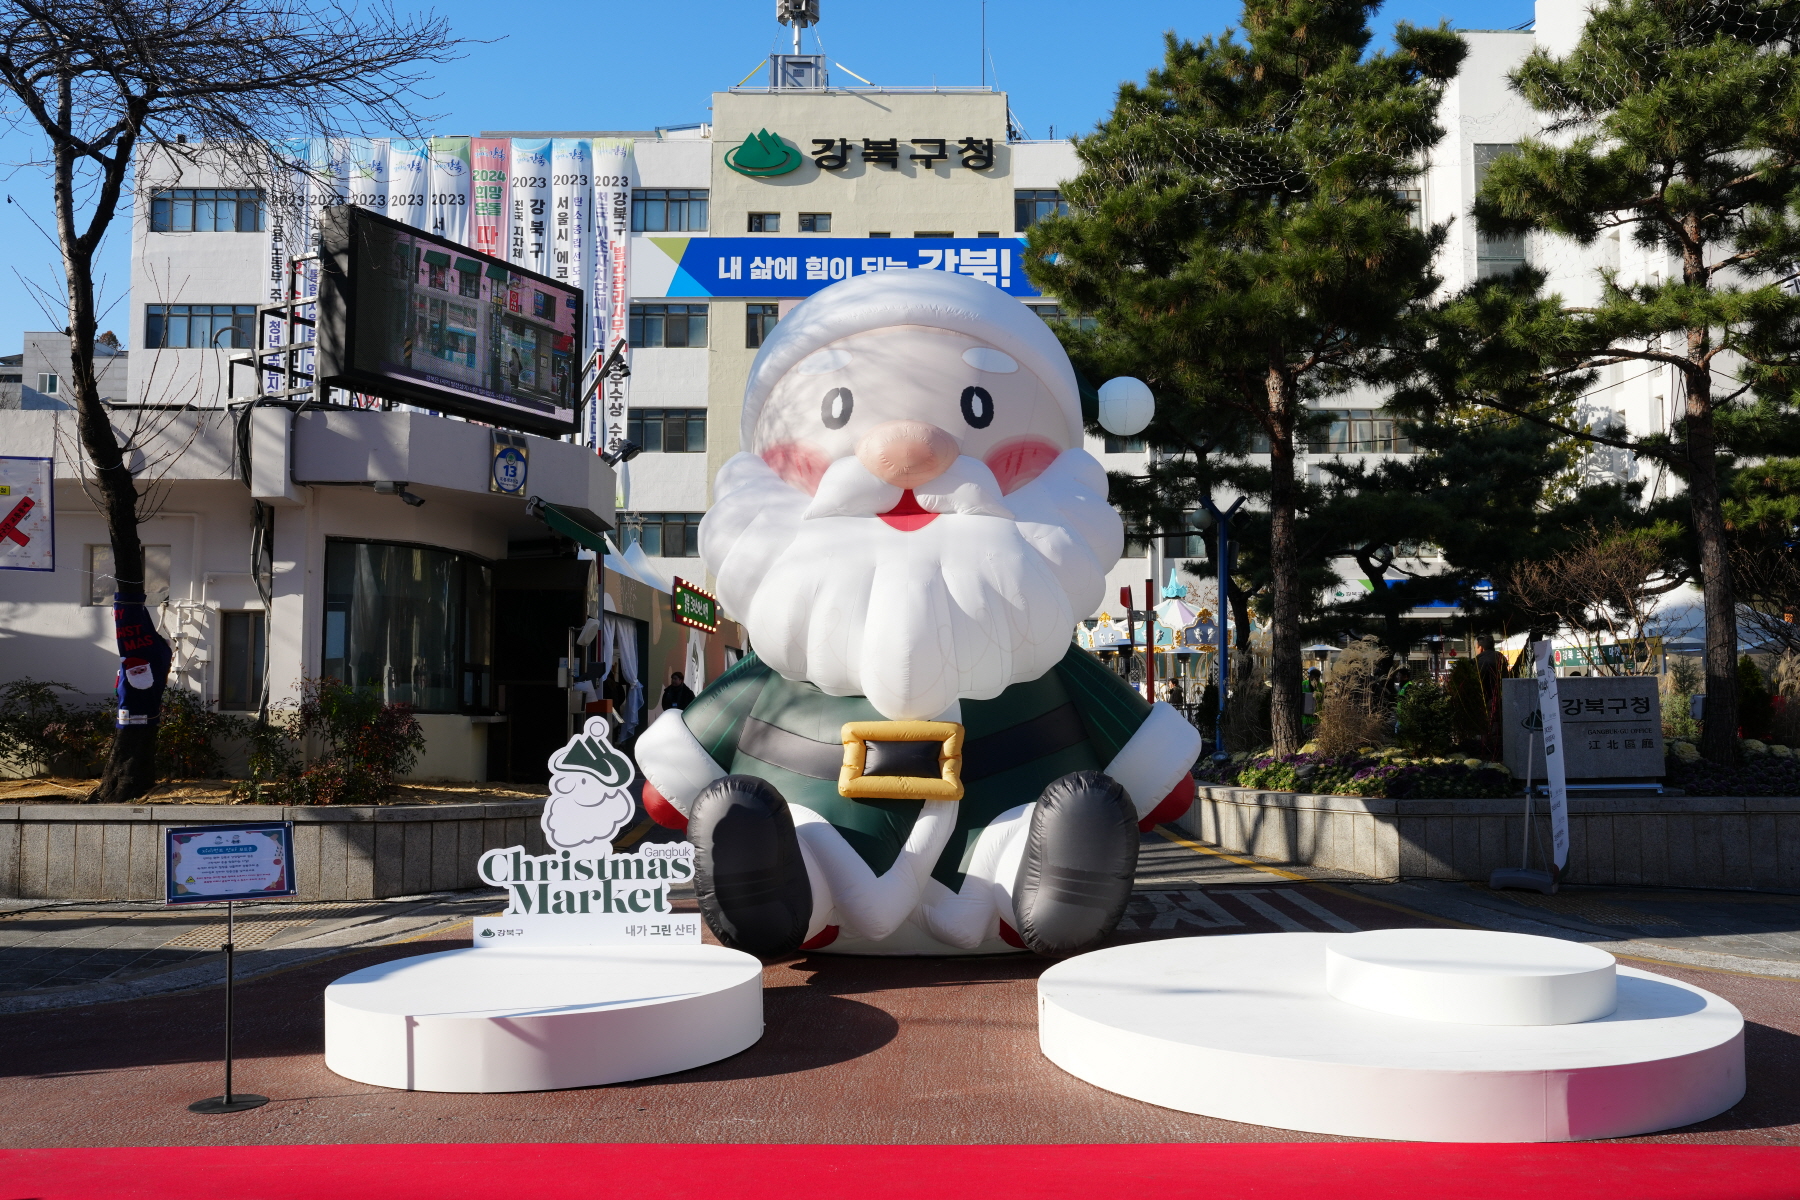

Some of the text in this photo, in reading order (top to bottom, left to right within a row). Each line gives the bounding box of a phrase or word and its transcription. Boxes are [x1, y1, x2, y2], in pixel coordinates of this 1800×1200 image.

[810, 136, 995, 171] 강북구청
[472, 169, 507, 182] 2024
[512, 176, 547, 189] 2023
[553, 174, 588, 186] 2023
[594, 175, 629, 187] 2023
[431, 193, 466, 206] 2023
[475, 185, 503, 200] 희망
[310, 194, 345, 206] 2023
[352, 194, 386, 206] 2023
[391, 193, 424, 207] 2023
[475, 202, 502, 217] 온돌
[613, 192, 628, 236] 강북구
[556, 196, 569, 242] 서울시
[512, 199, 524, 259] 전국 지자체
[529, 199, 546, 259] 강북구
[718, 256, 742, 280] 내
[749, 256, 798, 280] 삶에
[805, 256, 853, 280] 힘이
[503, 464, 517, 477] 13
[123, 634, 154, 652] MAS
[1562, 649, 1574, 660] 강북
[1562, 696, 1651, 716] 강북구청
[644, 847, 691, 860] Gangbuk
[482, 849, 692, 883] Christmas
[509, 878, 668, 915] Market
[496, 928, 524, 937] 강북구
[625, 923, 697, 937] 내가 그린 산타
